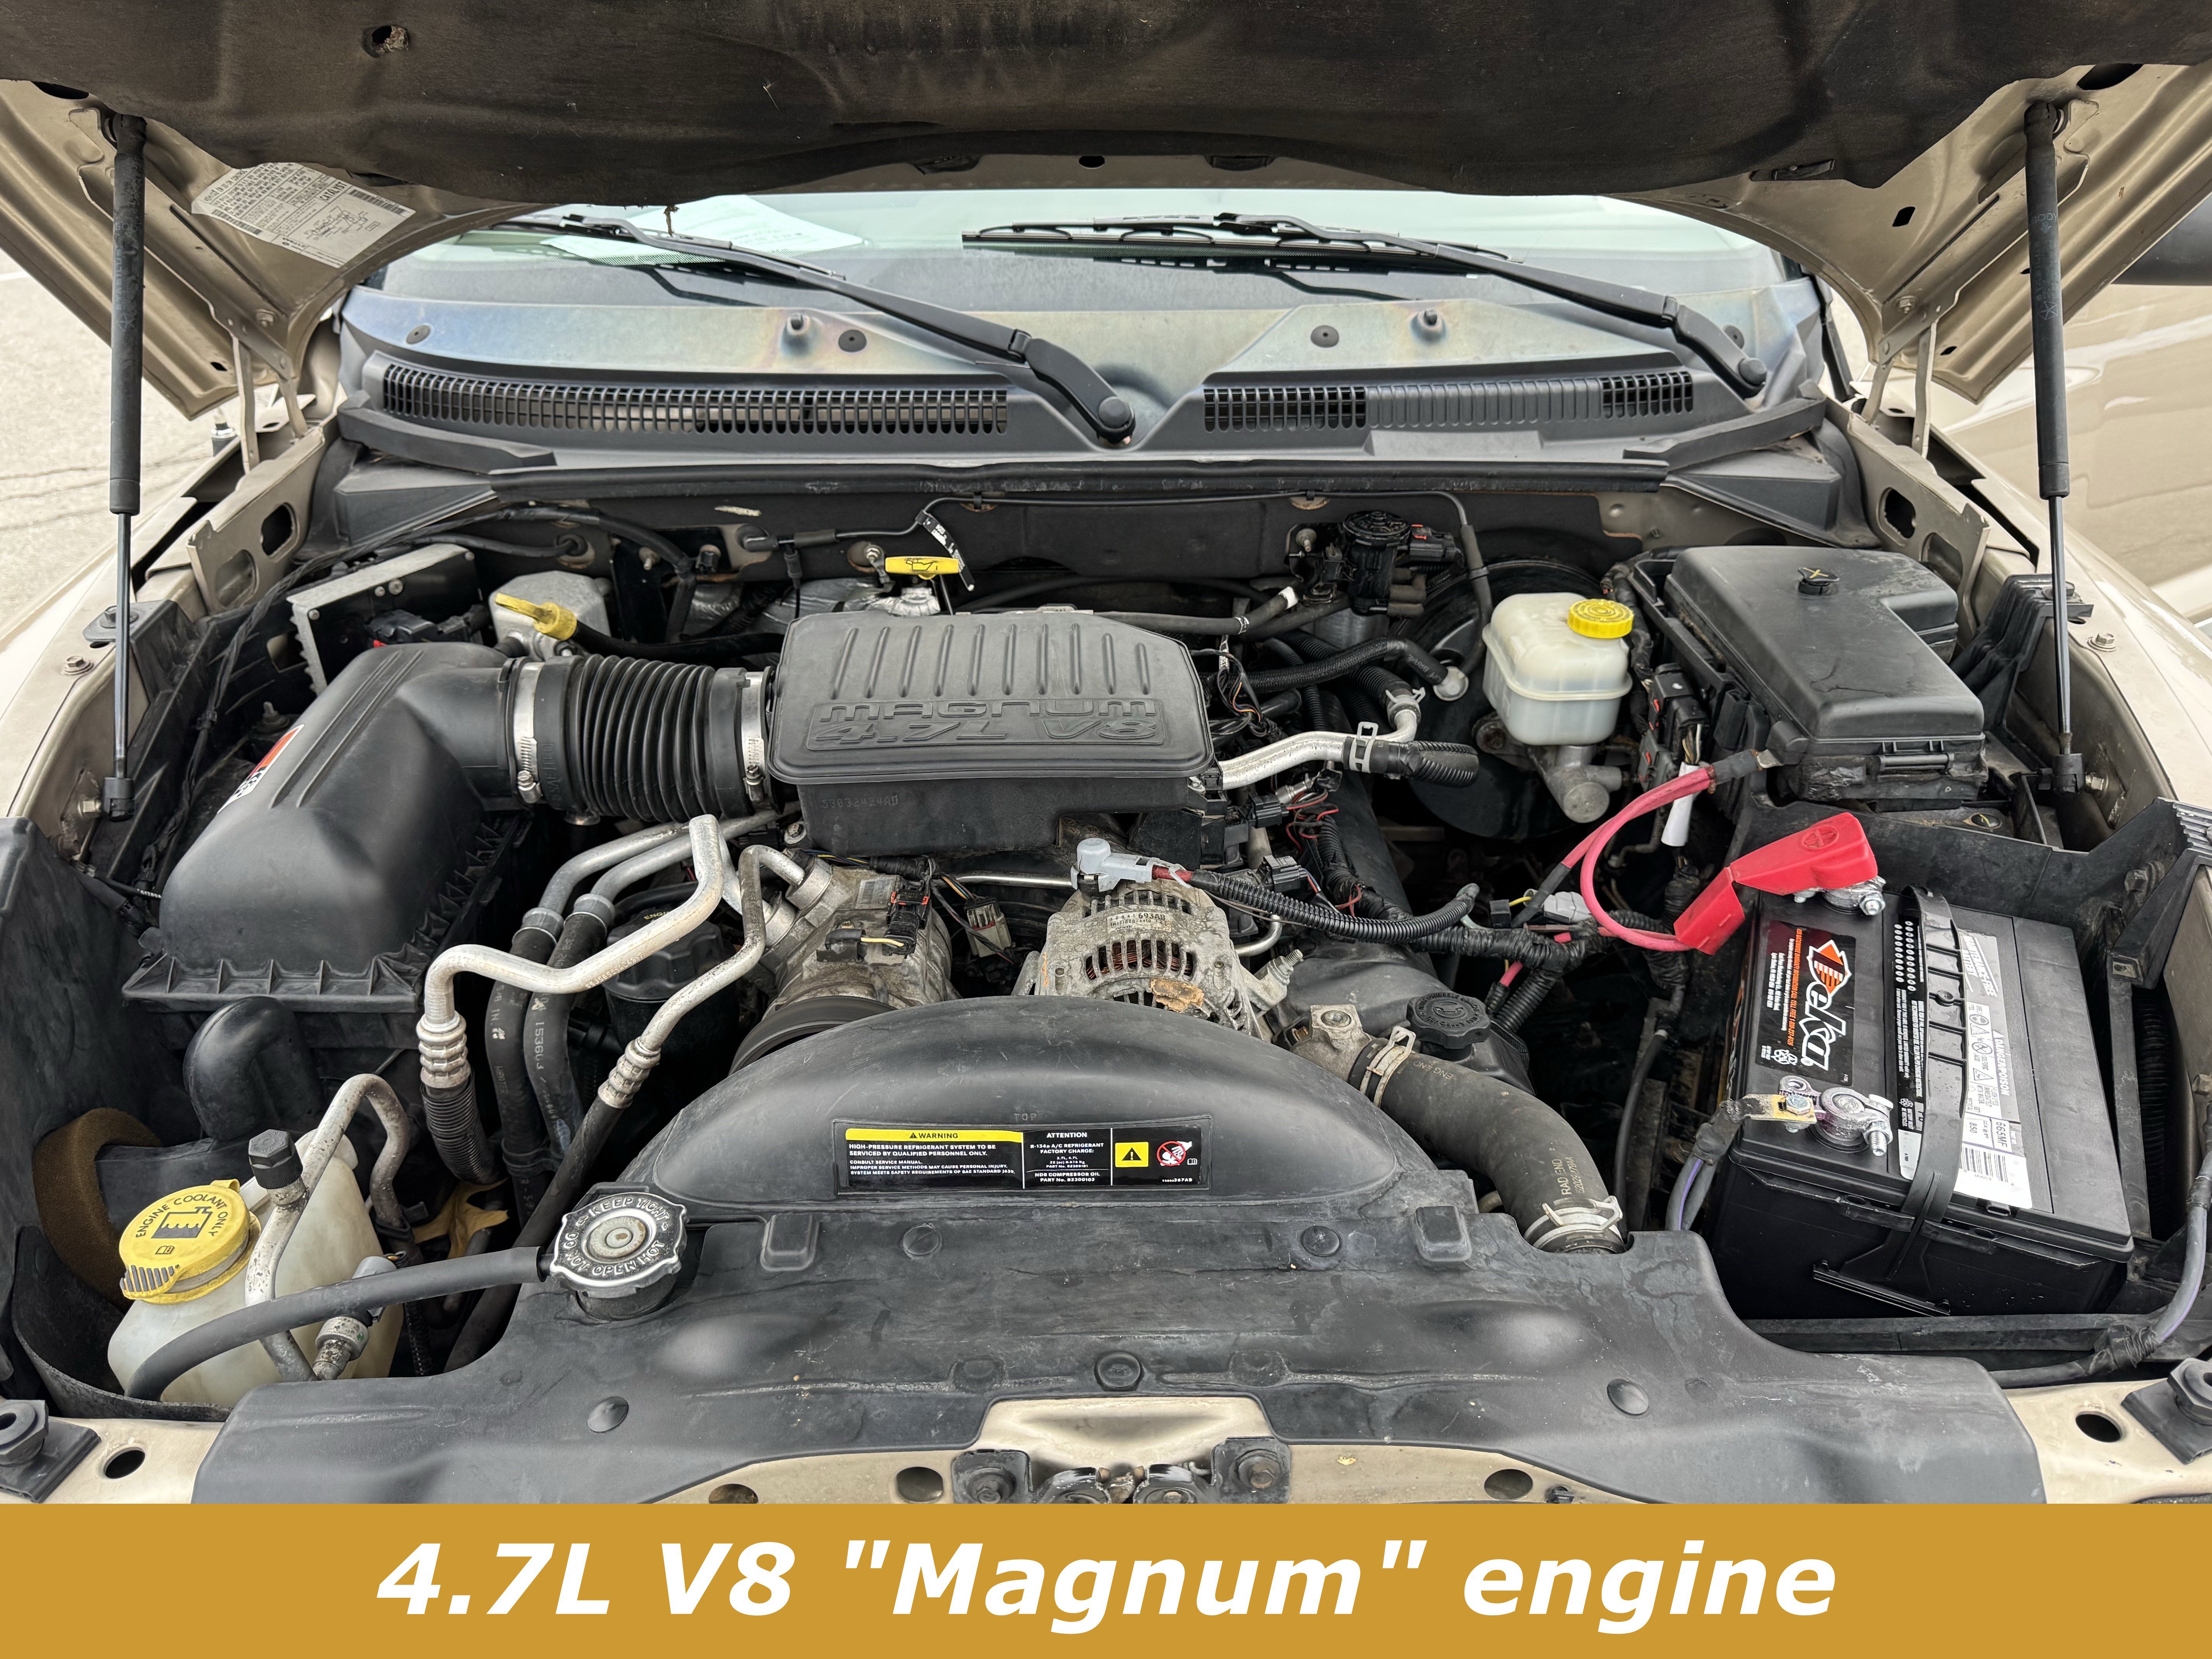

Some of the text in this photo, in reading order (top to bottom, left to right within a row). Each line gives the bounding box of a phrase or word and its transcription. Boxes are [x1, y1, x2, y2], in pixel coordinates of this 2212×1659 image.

[319, 181, 347, 201] CATALYST
[821, 699, 1156, 722] MAGNUM
[813, 718, 1157, 744] 4.7L V8
[1799, 940, 1851, 1070] Deka
[1413, 1061, 1454, 1080] ENG END
[1994, 1039, 2010, 1096] DANGER/POISON
[1996, 1122, 2007, 1147] 665MF
[1551, 1159, 1572, 1195] RAD END
[136, 1194, 228, 1238] ENGINE COOLANT ONLY
[588, 1197, 670, 1221] KEEP TIGHT
[563, 1232, 579, 1249] DO
[637, 1240, 665, 1264] HOT
[565, 1250, 590, 1271] NOT
[592, 1261, 637, 1276] OPEN
